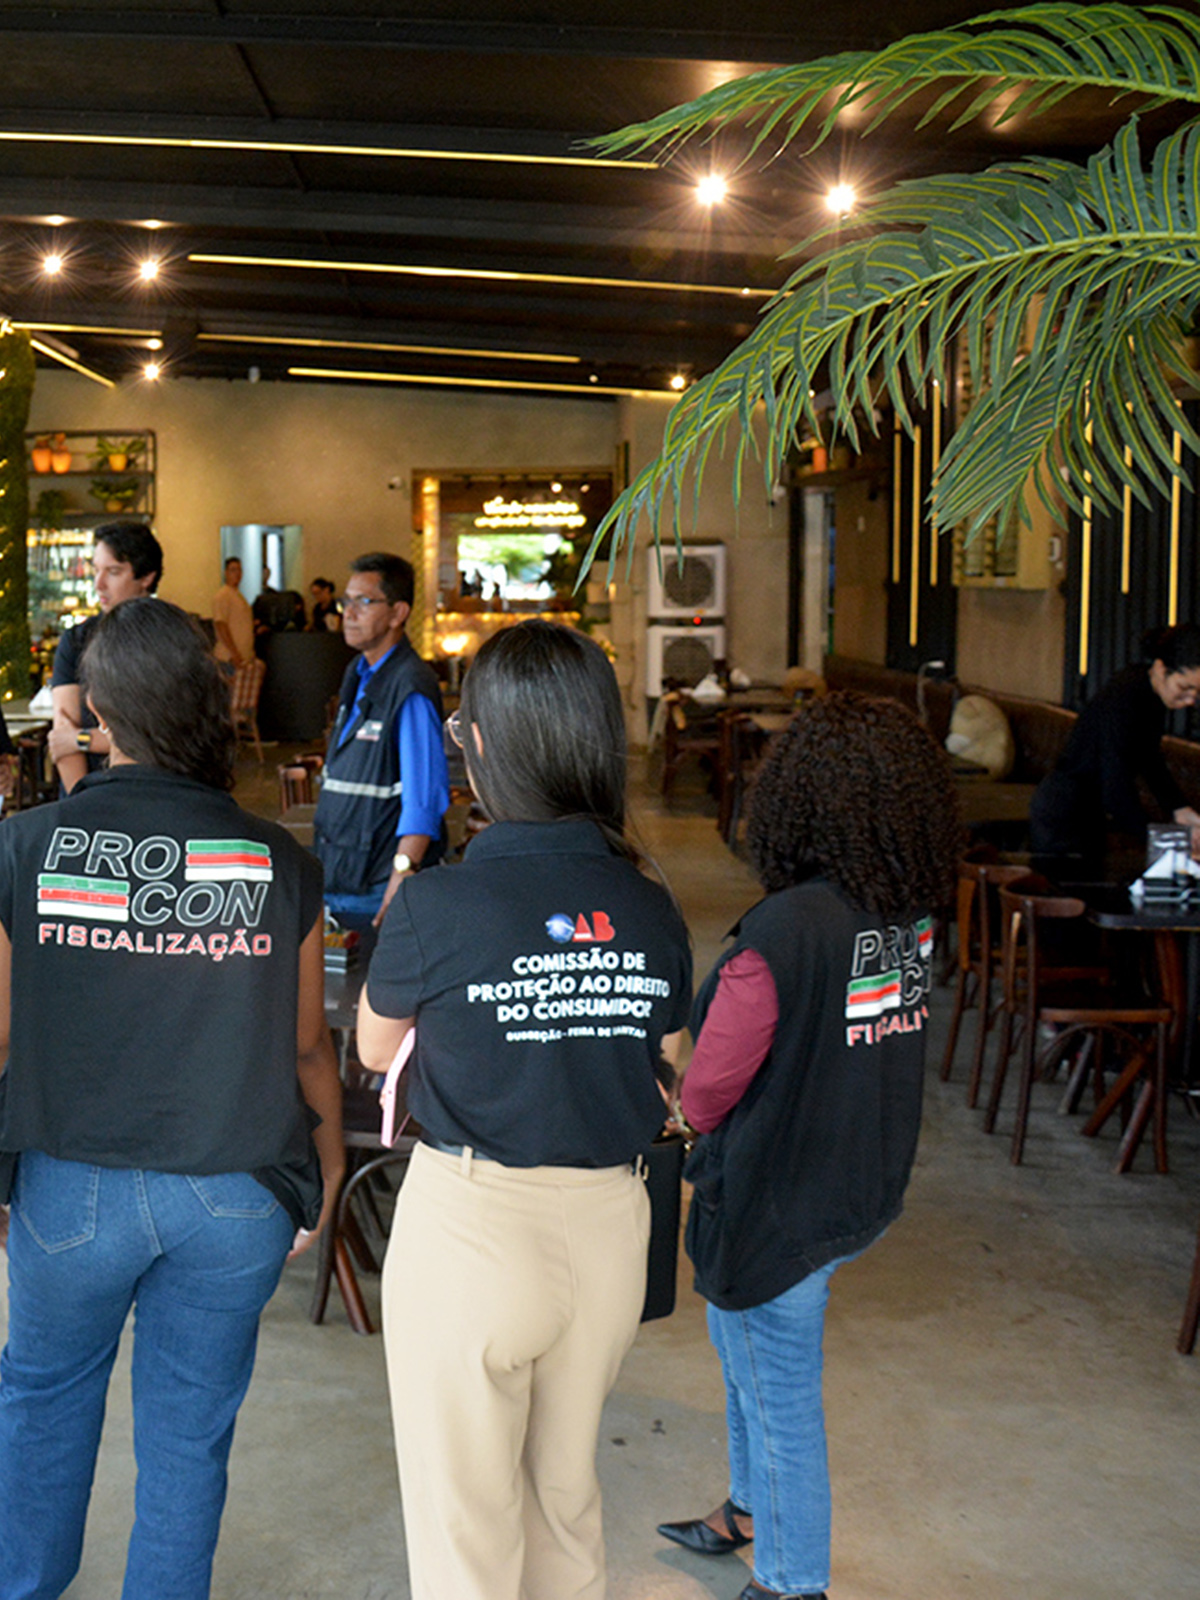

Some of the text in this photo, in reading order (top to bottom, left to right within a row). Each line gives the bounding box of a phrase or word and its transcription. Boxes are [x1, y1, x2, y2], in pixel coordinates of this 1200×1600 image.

[44, 827, 181, 881] PRO
[131, 881, 269, 927] CON
[38, 923, 272, 962] FISCALIZAÇÃO
[512, 947, 646, 975] COMISSÃO DE
[467, 973, 670, 1003] PROTEÇÃO AO DIREITO
[497, 1003, 529, 1022] DO
